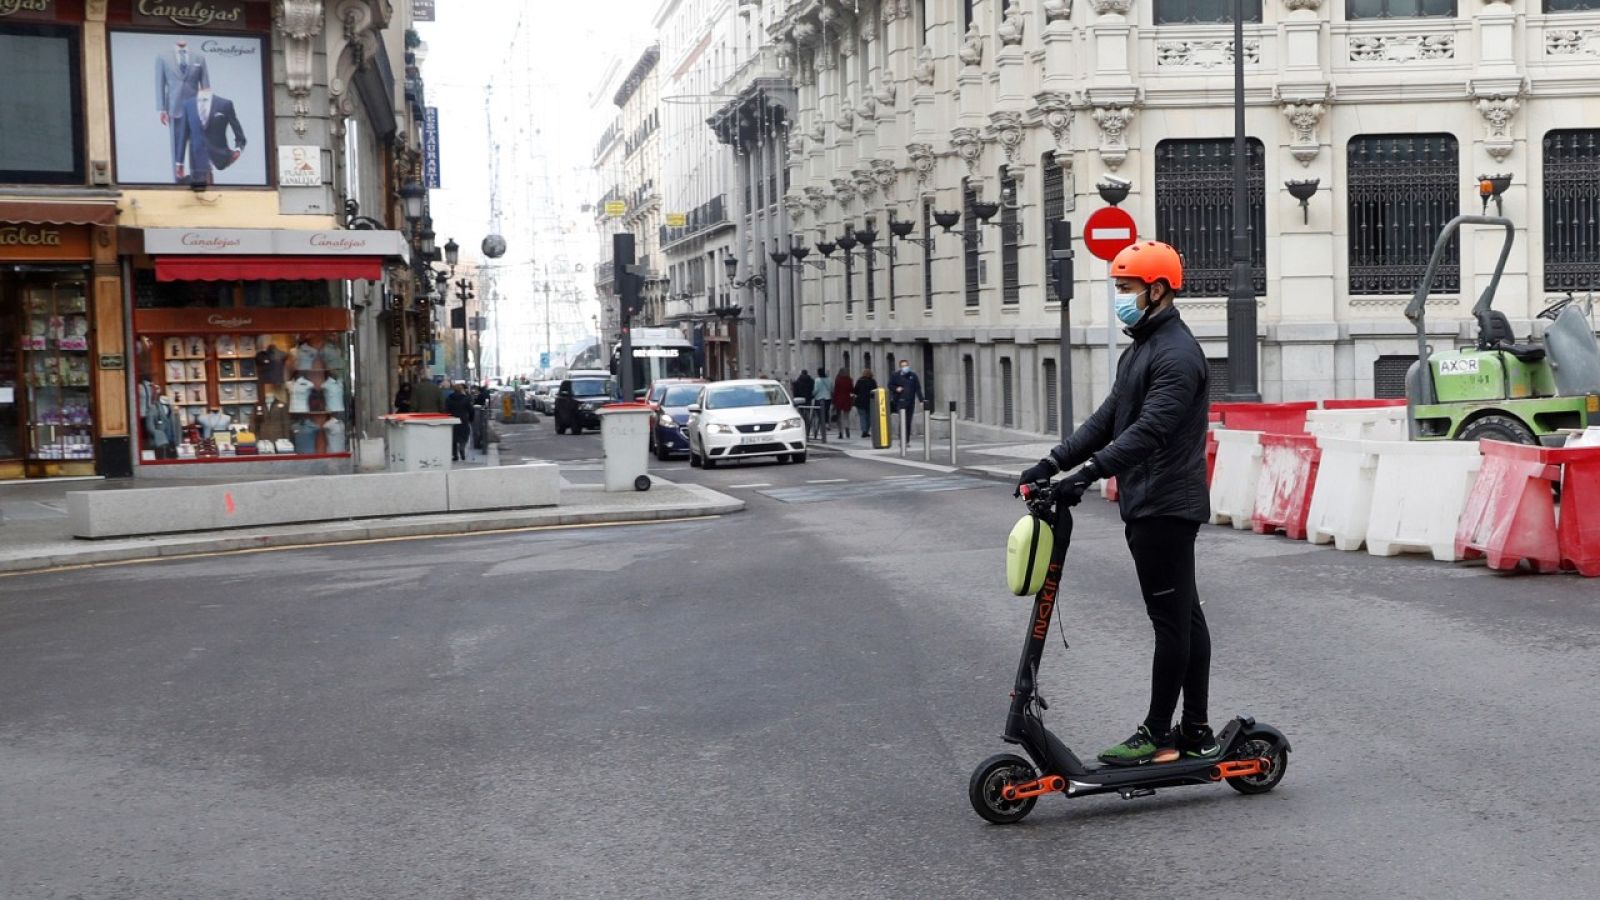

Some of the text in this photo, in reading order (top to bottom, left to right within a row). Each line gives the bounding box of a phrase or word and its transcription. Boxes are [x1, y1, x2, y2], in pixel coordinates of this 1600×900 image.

[139, 0, 240, 26] Canalejas
[200, 39, 257, 56] Canalejas
[425, 108, 438, 188] RESTAURANTE
[181, 232, 241, 249] Canalejas
[309, 233, 366, 250] Canalejas
[1441, 359, 1478, 371] AXOR
